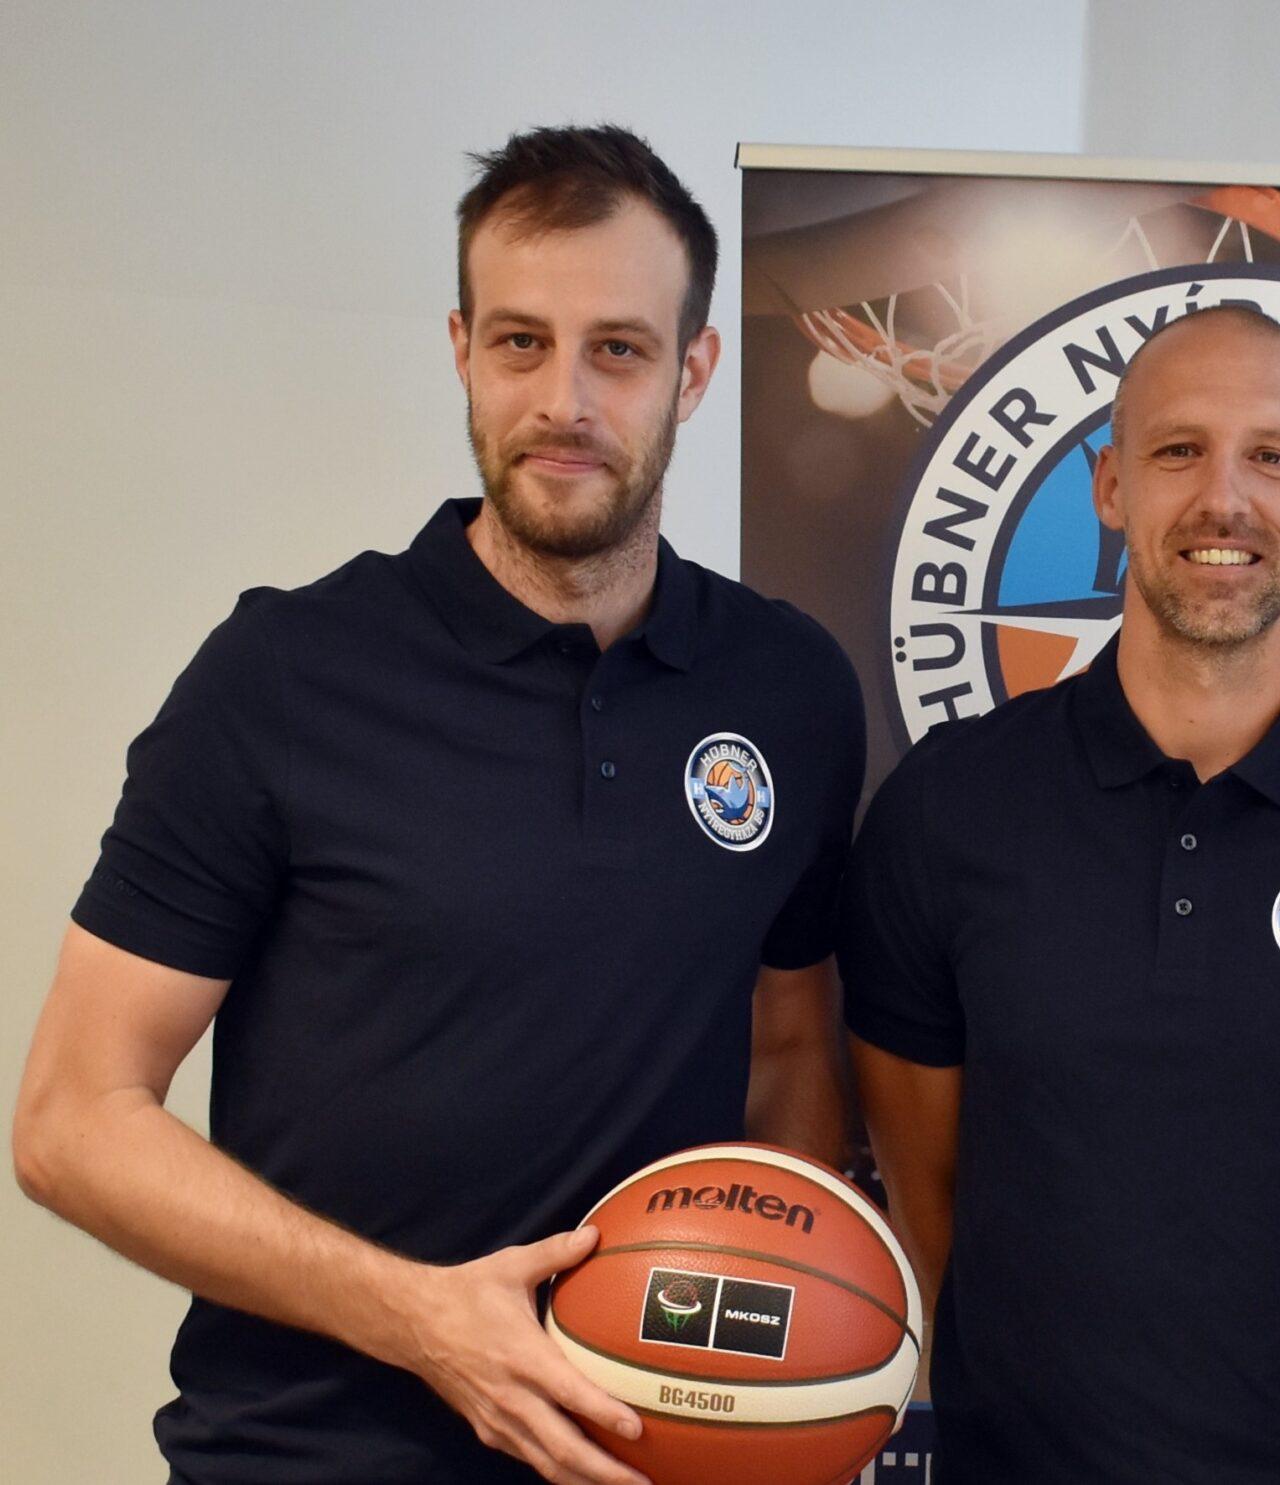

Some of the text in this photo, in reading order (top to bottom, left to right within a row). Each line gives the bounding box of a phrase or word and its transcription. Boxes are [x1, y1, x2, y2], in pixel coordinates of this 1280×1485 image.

[893, 387, 1058, 722] HÜBNER
[646, 1183, 815, 1235] molten
[724, 1309, 781, 1326] MKOSZ
[659, 1385, 736, 1413] BG4500
